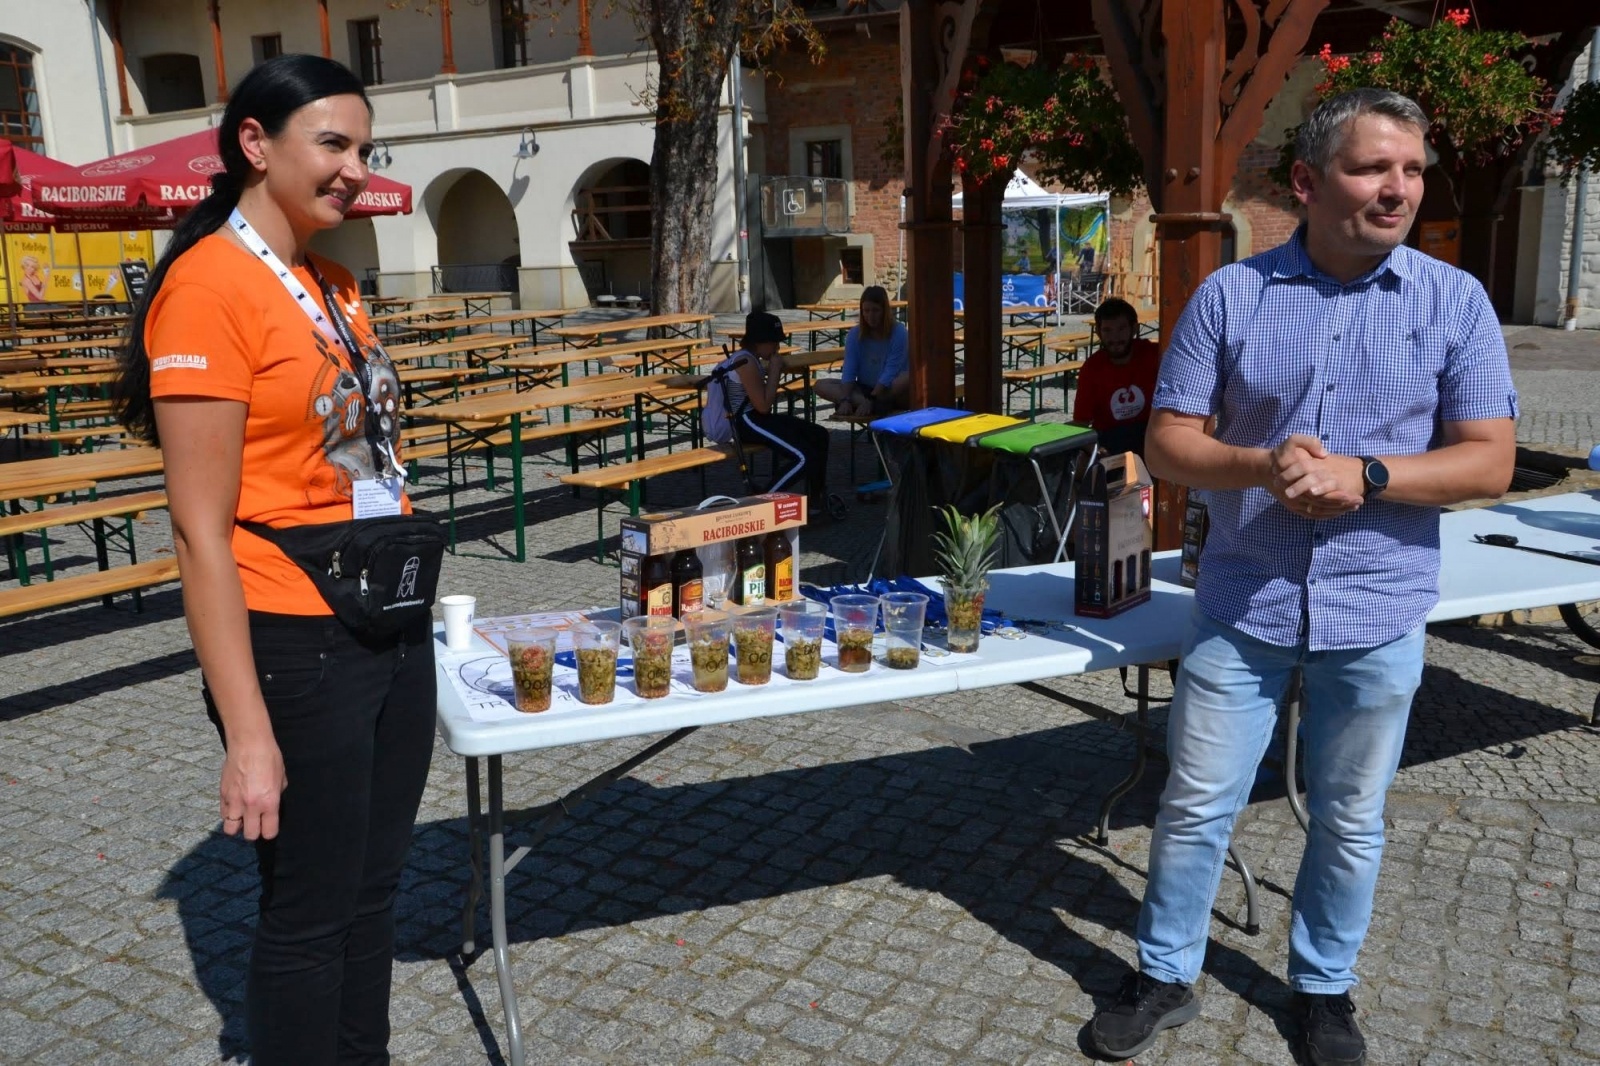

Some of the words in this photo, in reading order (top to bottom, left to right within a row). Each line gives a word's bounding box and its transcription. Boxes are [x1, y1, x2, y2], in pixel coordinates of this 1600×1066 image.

[41, 185, 126, 203] RACIBORSKIE
[354, 191, 403, 207] ORSKIE
[54, 275, 70, 288] Belle
[703, 519, 766, 541] RACIBORSKIE
